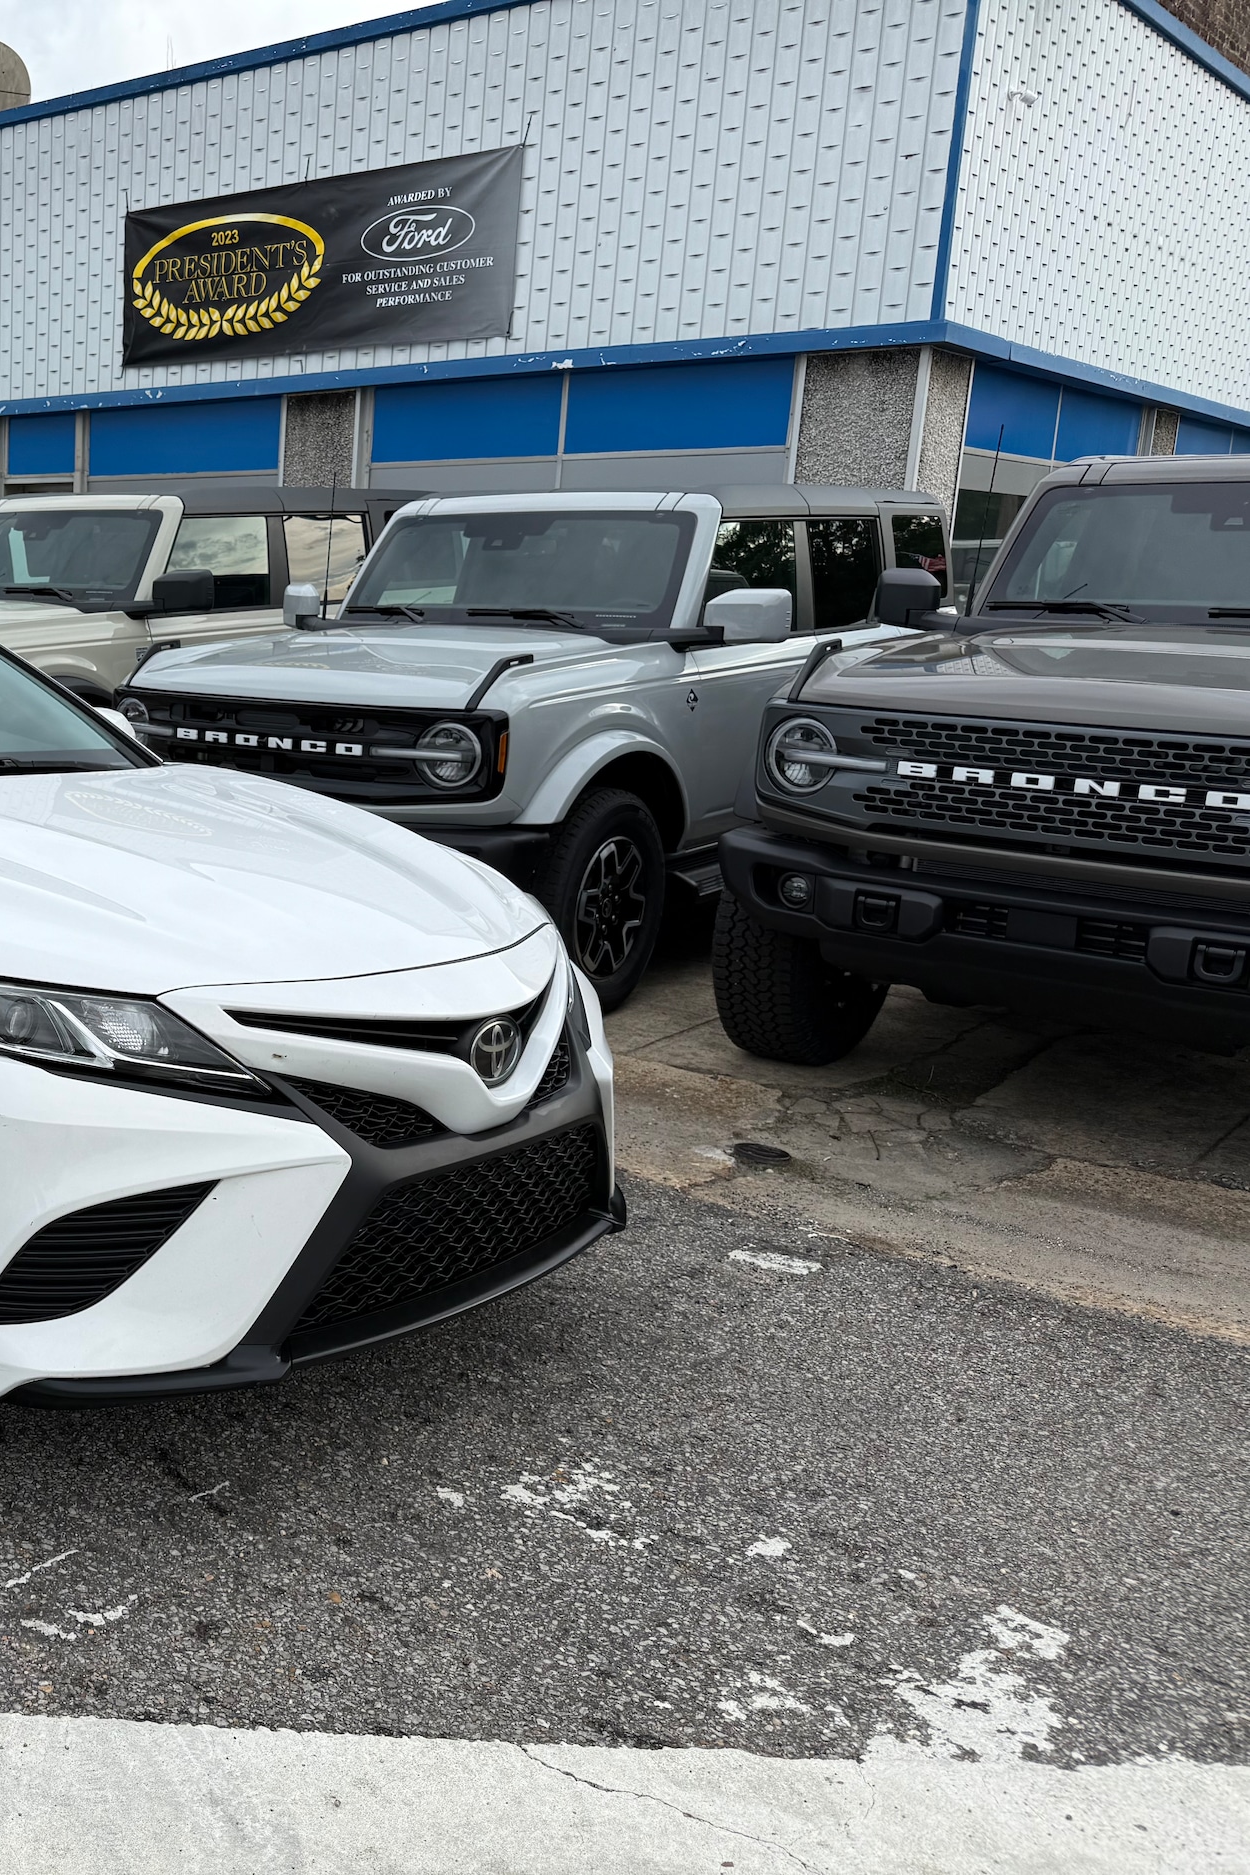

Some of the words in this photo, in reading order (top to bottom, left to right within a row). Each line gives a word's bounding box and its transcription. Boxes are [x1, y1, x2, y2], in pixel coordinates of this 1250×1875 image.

[387, 189, 435, 207] AWARDED
[437, 186, 452, 199] BY
[211, 229, 240, 247] 2023
[381, 212, 453, 253] Ford
[152, 240, 307, 284] PRESIDENT'S
[342, 272, 362, 284] FOR
[363, 263, 434, 282] OUTSTANDING
[436, 256, 494, 272] CUSTOMER
[182, 271, 267, 304] AWARD
[366, 281, 408, 295] SERVICE
[410, 278, 432, 290] AND
[433, 274, 466, 287] SALES
[376, 290, 452, 308] PERFORMANCE
[176, 727, 363, 756] BRONCO
[896, 760, 1250, 810] BRONCO
